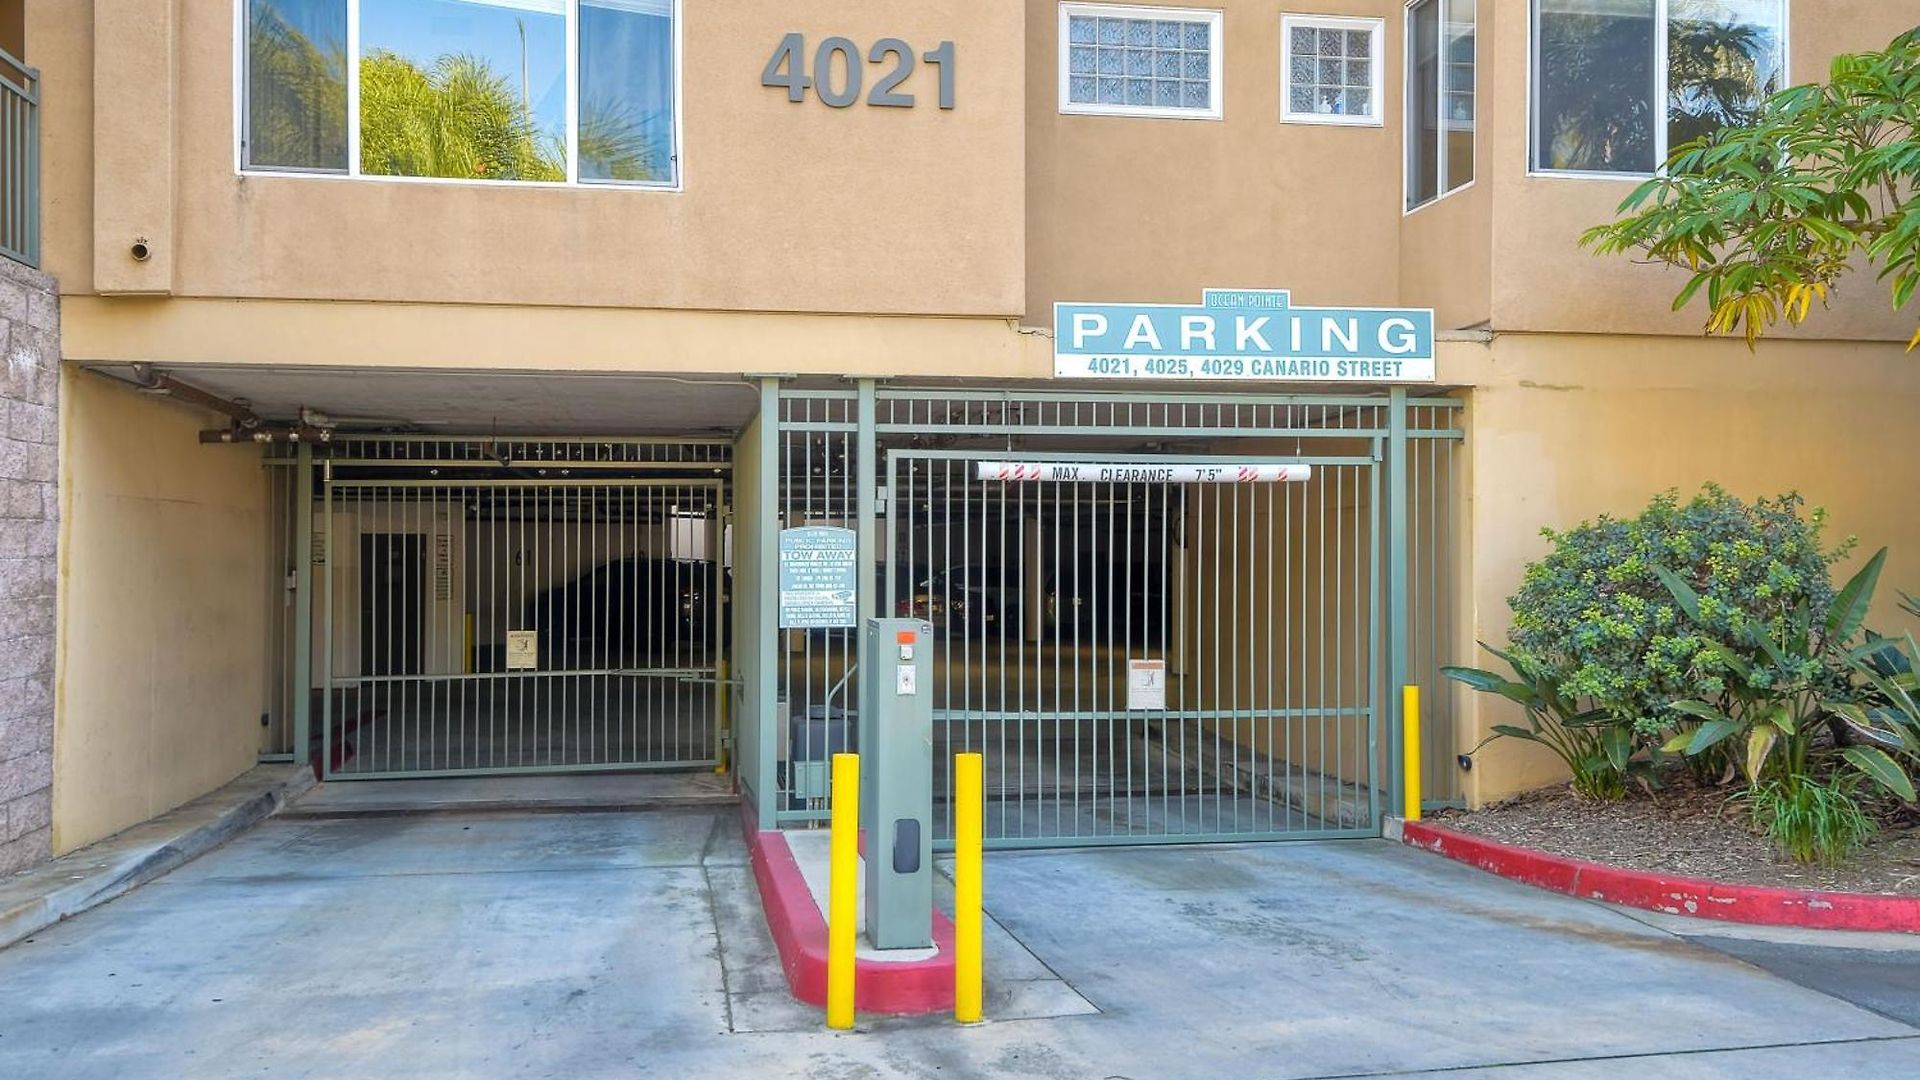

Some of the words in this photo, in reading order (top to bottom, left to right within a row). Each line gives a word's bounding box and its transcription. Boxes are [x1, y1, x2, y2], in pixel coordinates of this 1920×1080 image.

[761, 32, 955, 109] 4021
[1211, 294, 1244, 307] OCEAN
[1248, 295, 1284, 308] POINTE
[1072, 313, 1418, 354] PARKING
[1087, 357, 1138, 377] 4021,
[1144, 358, 1195, 377] 4025,
[1200, 359, 1244, 376] 4029
[1251, 360, 1330, 377] CANARIO
[1337, 360, 1403, 377] STREET
[1100, 468, 1174, 482] CLEARANCE
[784, 551, 813, 560] TOW
[816, 551, 853, 560] AWAY
